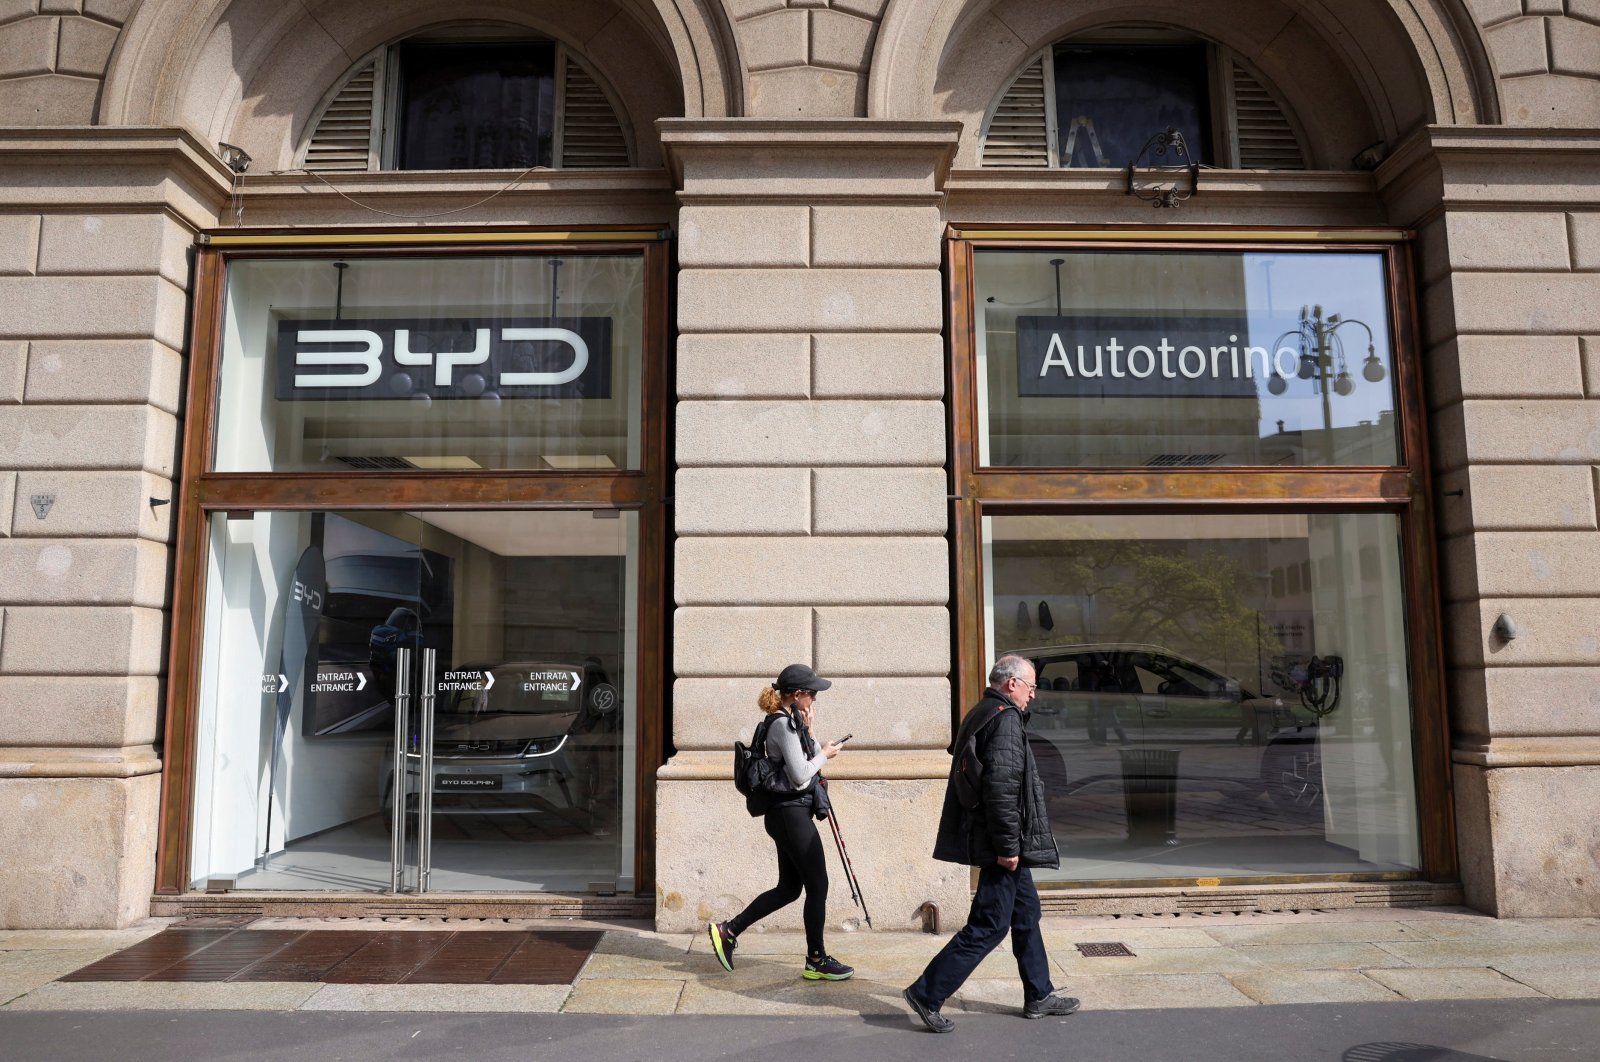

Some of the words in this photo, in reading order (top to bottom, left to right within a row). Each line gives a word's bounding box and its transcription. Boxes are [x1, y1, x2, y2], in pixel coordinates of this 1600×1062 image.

[294, 327, 589, 387] BYD
[1039, 332, 1299, 379] Autotorino
[293, 580, 322, 610] BYD
[316, 673, 354, 682] ENTRATA
[444, 671, 482, 680] ENTRATA
[530, 672, 568, 680] ENTRATA
[310, 683, 354, 692] ENTRANCE
[438, 682, 482, 691] ENTRANCE
[523, 682, 568, 691] ENTRANCE
